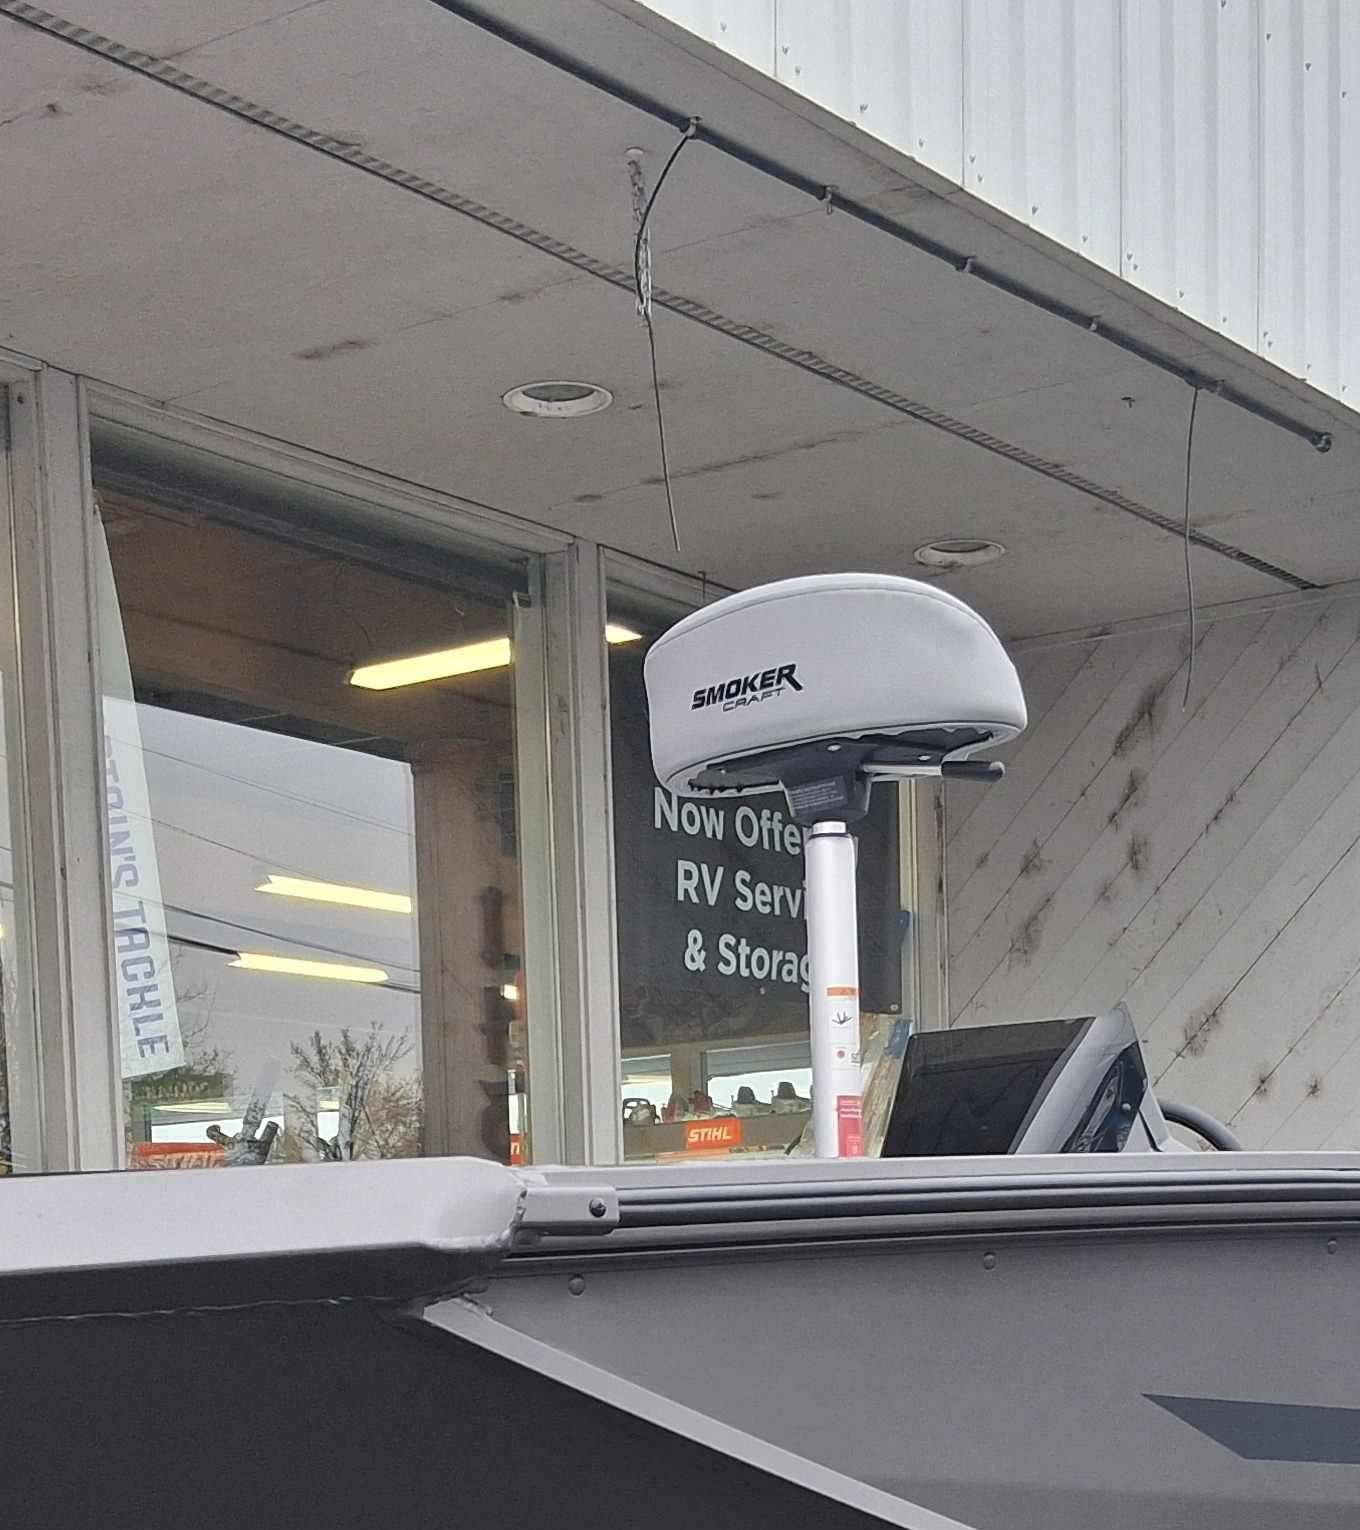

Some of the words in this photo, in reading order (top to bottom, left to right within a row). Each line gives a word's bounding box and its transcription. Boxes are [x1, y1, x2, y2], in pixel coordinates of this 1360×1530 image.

[691, 663, 804, 710] SMOKER
[722, 686, 786, 712] CRAFT
[654, 786, 725, 840] Now
[677, 859, 724, 906] RV
[684, 929, 706, 972] &
[112, 899, 170, 1058] TACKLE
[687, 1126, 735, 1143] STIHL
